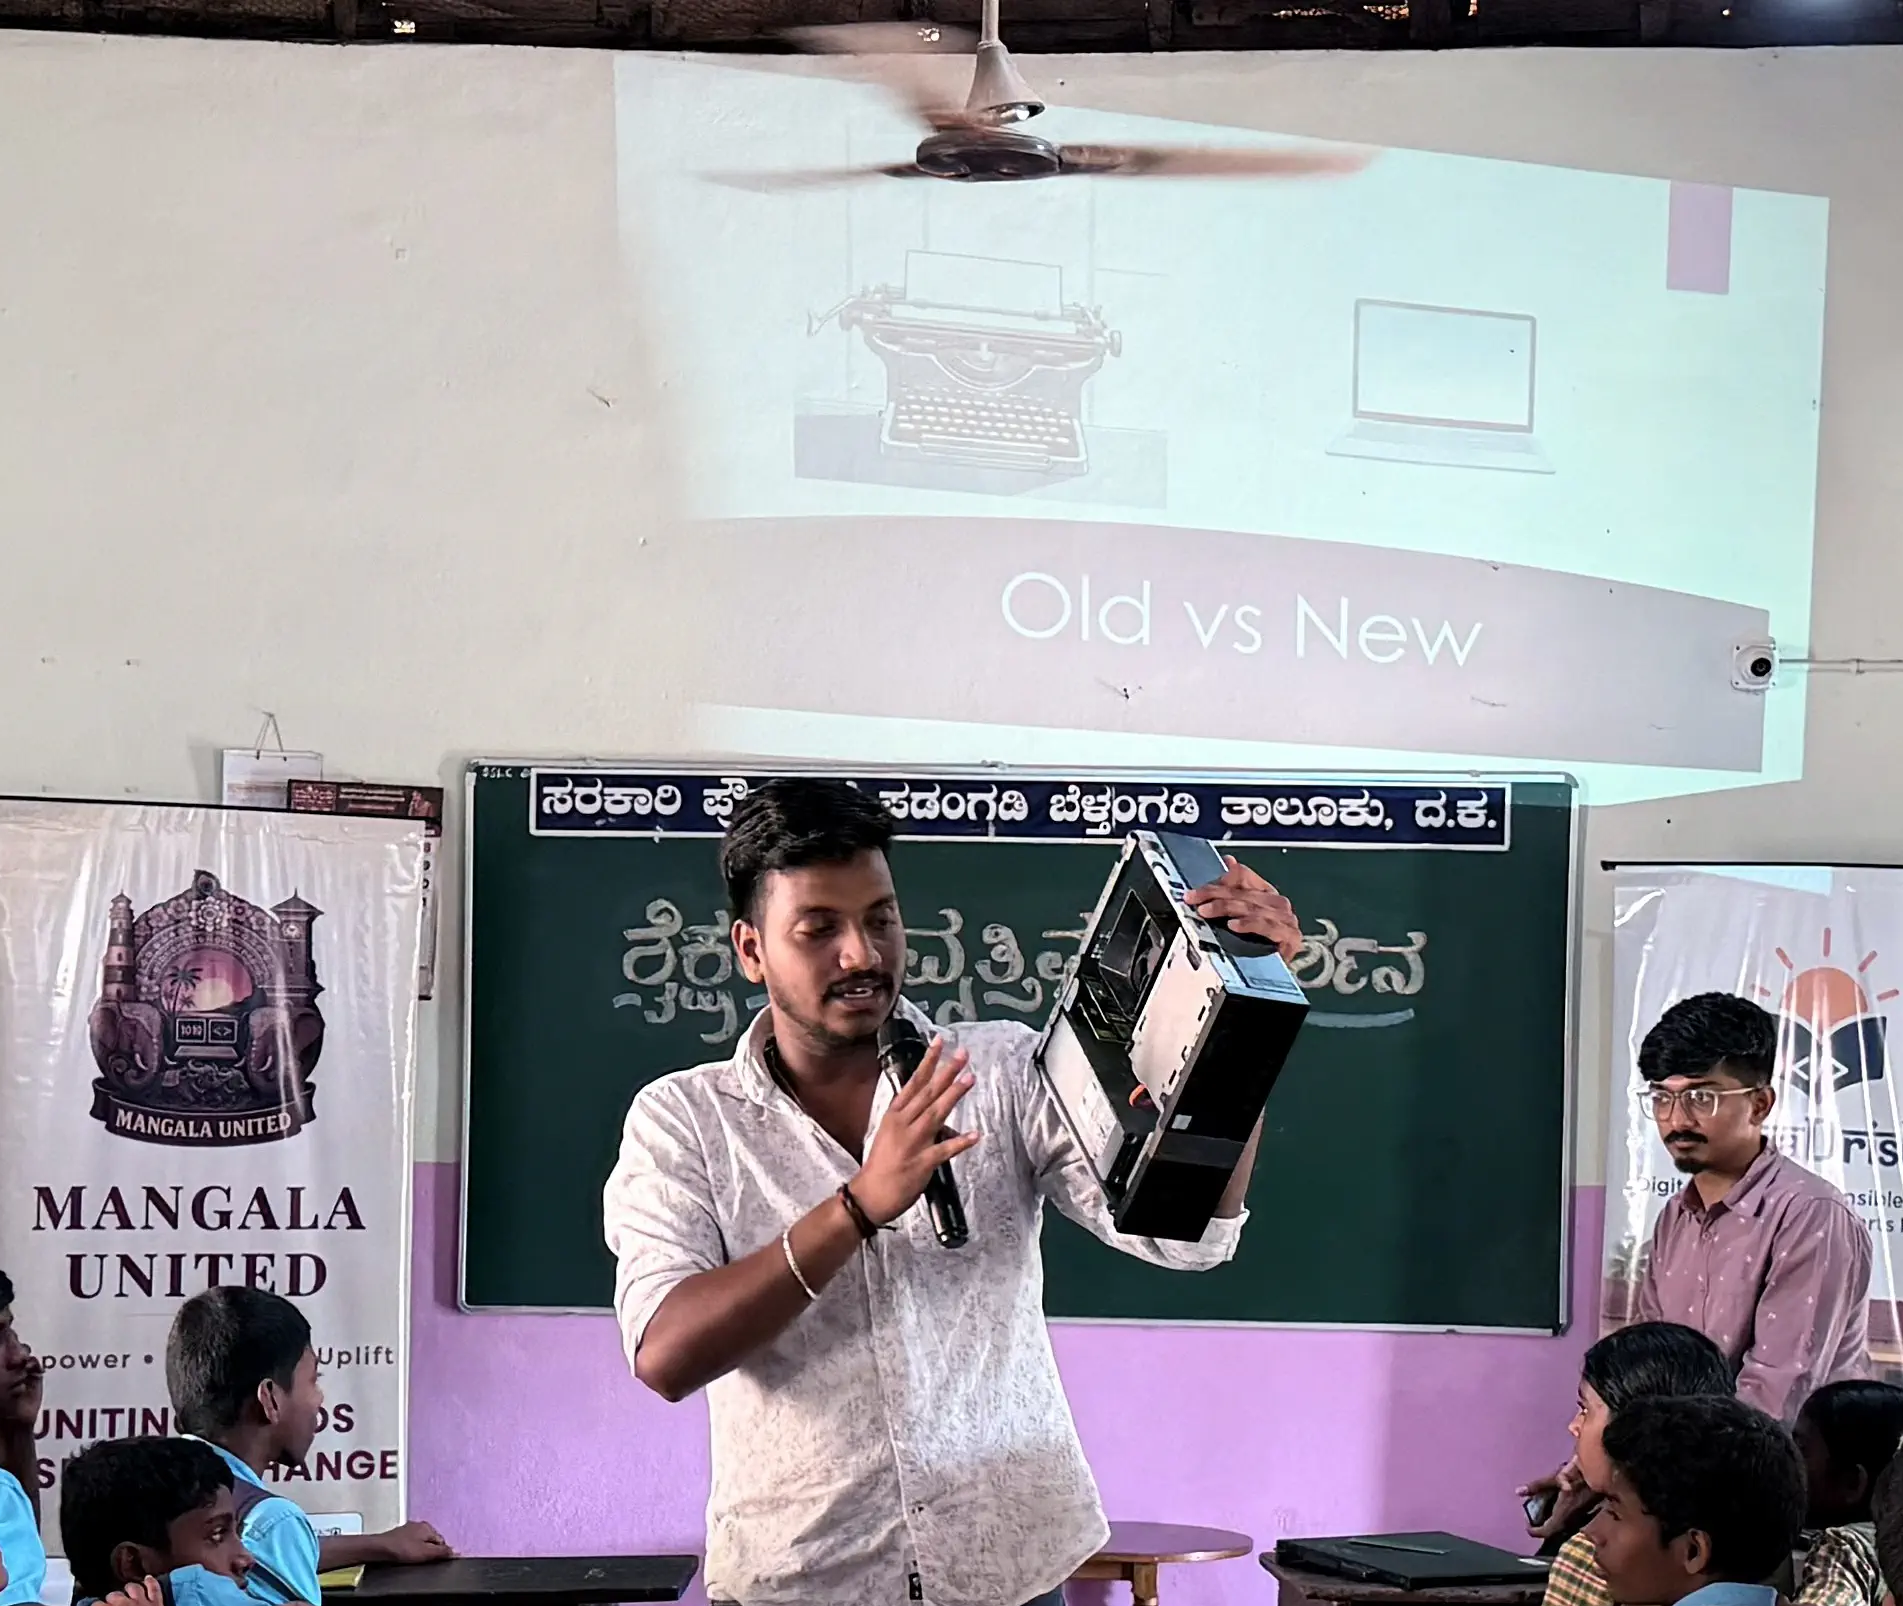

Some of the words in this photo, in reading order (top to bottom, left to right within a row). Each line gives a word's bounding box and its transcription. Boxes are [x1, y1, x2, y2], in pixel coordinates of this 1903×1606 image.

[1001, 571, 1153, 646] Old
[1182, 600, 1264, 656] vs
[1296, 592, 1485, 667] New
[541, 777, 682, 816] ಸರಕಾರಿ
[879, 782, 1029, 822] ಪಡಂಗಡಿ
[1220, 788, 1394, 831] ತಾಲೂಕು,
[1414, 790, 1497, 829] ದ.ಕ.
[115, 1107, 213, 1139] MANGALA
[218, 1111, 292, 1138] UNITED
[32, 1185, 365, 1231] MANGALA
[66, 1253, 328, 1299] UNITED
[317, 1345, 395, 1370] Uplift
[33, 1406, 179, 1441] UNITIN
[262, 1449, 399, 1484] HANGE
